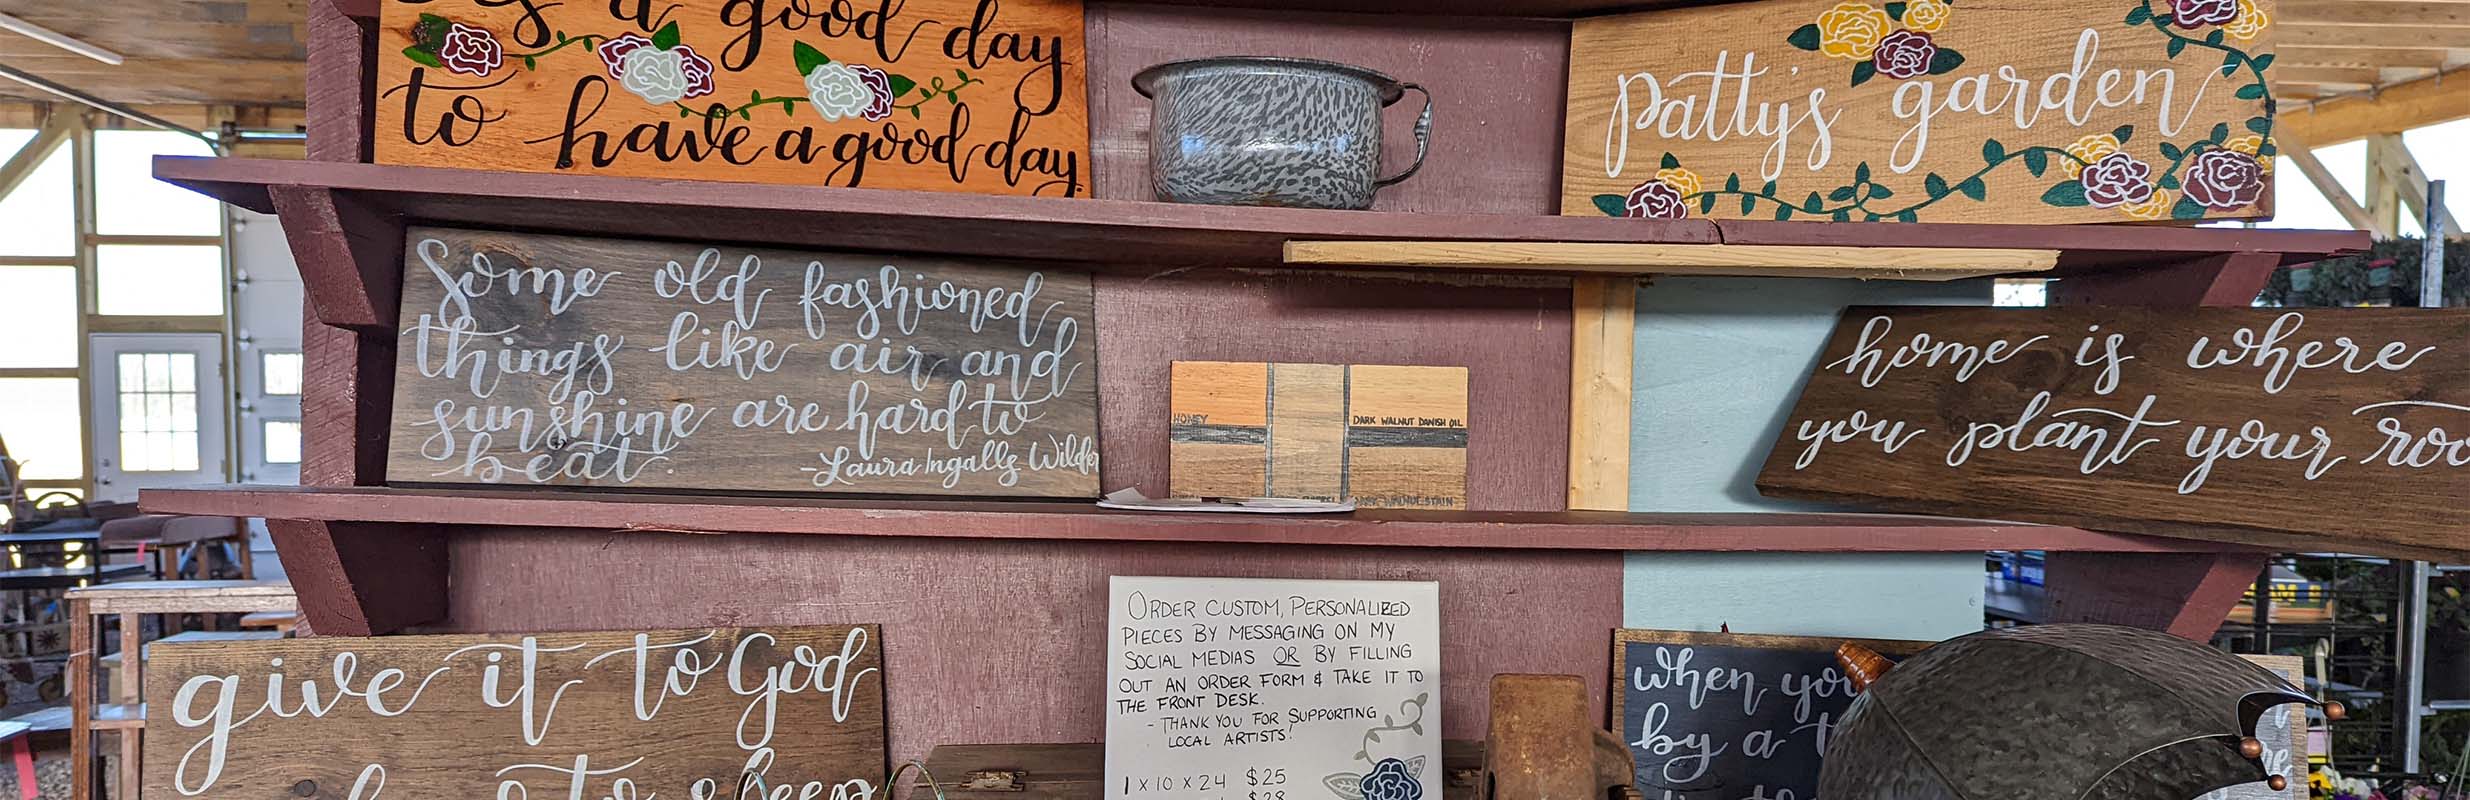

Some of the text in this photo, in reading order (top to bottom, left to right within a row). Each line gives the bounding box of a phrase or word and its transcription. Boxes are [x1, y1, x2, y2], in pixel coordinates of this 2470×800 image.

[720, 0, 941, 72] good
[943, 0, 1073, 116] day
[1889, 28, 2237, 175] garden
[382, 68, 1084, 197] to have a good day
[417, 238, 1064, 348] Some old fashioned
[402, 311, 1083, 399] things like air and
[1826, 311, 2437, 394] home is where
[412, 380, 1054, 460] sunshine are hard to
[1353, 415, 1463, 428] DARK WALNUT DANISH OIL
[1795, 410, 1927, 470] you
[1946, 391, 2181, 475] plant
[2177, 419, 2347, 495] your
[431, 432, 675, 484] beat.
[924, 440, 1021, 489] Ingalls
[1121, 622, 1396, 646] PIECES BY MESSAGING ON MY
[1128, 591, 1411, 620] ORDER CUSTOM, PERSONALIZED
[1119, 669, 1424, 693] OUT AN ORDER FORM & TAKE IT TO
[1124, 643, 1412, 671] SOCIAL MEDIAS OR BY FILLING
[1633, 646, 1767, 716] when
[171, 627, 878, 796] give it to God
[1116, 692, 1264, 716] THE FRONT DESK.
[1160, 715, 1209, 734] THANK
[1215, 714, 1242, 728] YOU
[1252, 711, 1279, 726] FOR
[1289, 706, 1377, 724] SUPPORTING
[1168, 724, 1294, 748] LOCAL ARTISTS!
[1631, 702, 1728, 784] by
[1742, 729, 1786, 759] a
[1156, 776, 1173, 791] 10
[1199, 773, 1226, 790] 24
